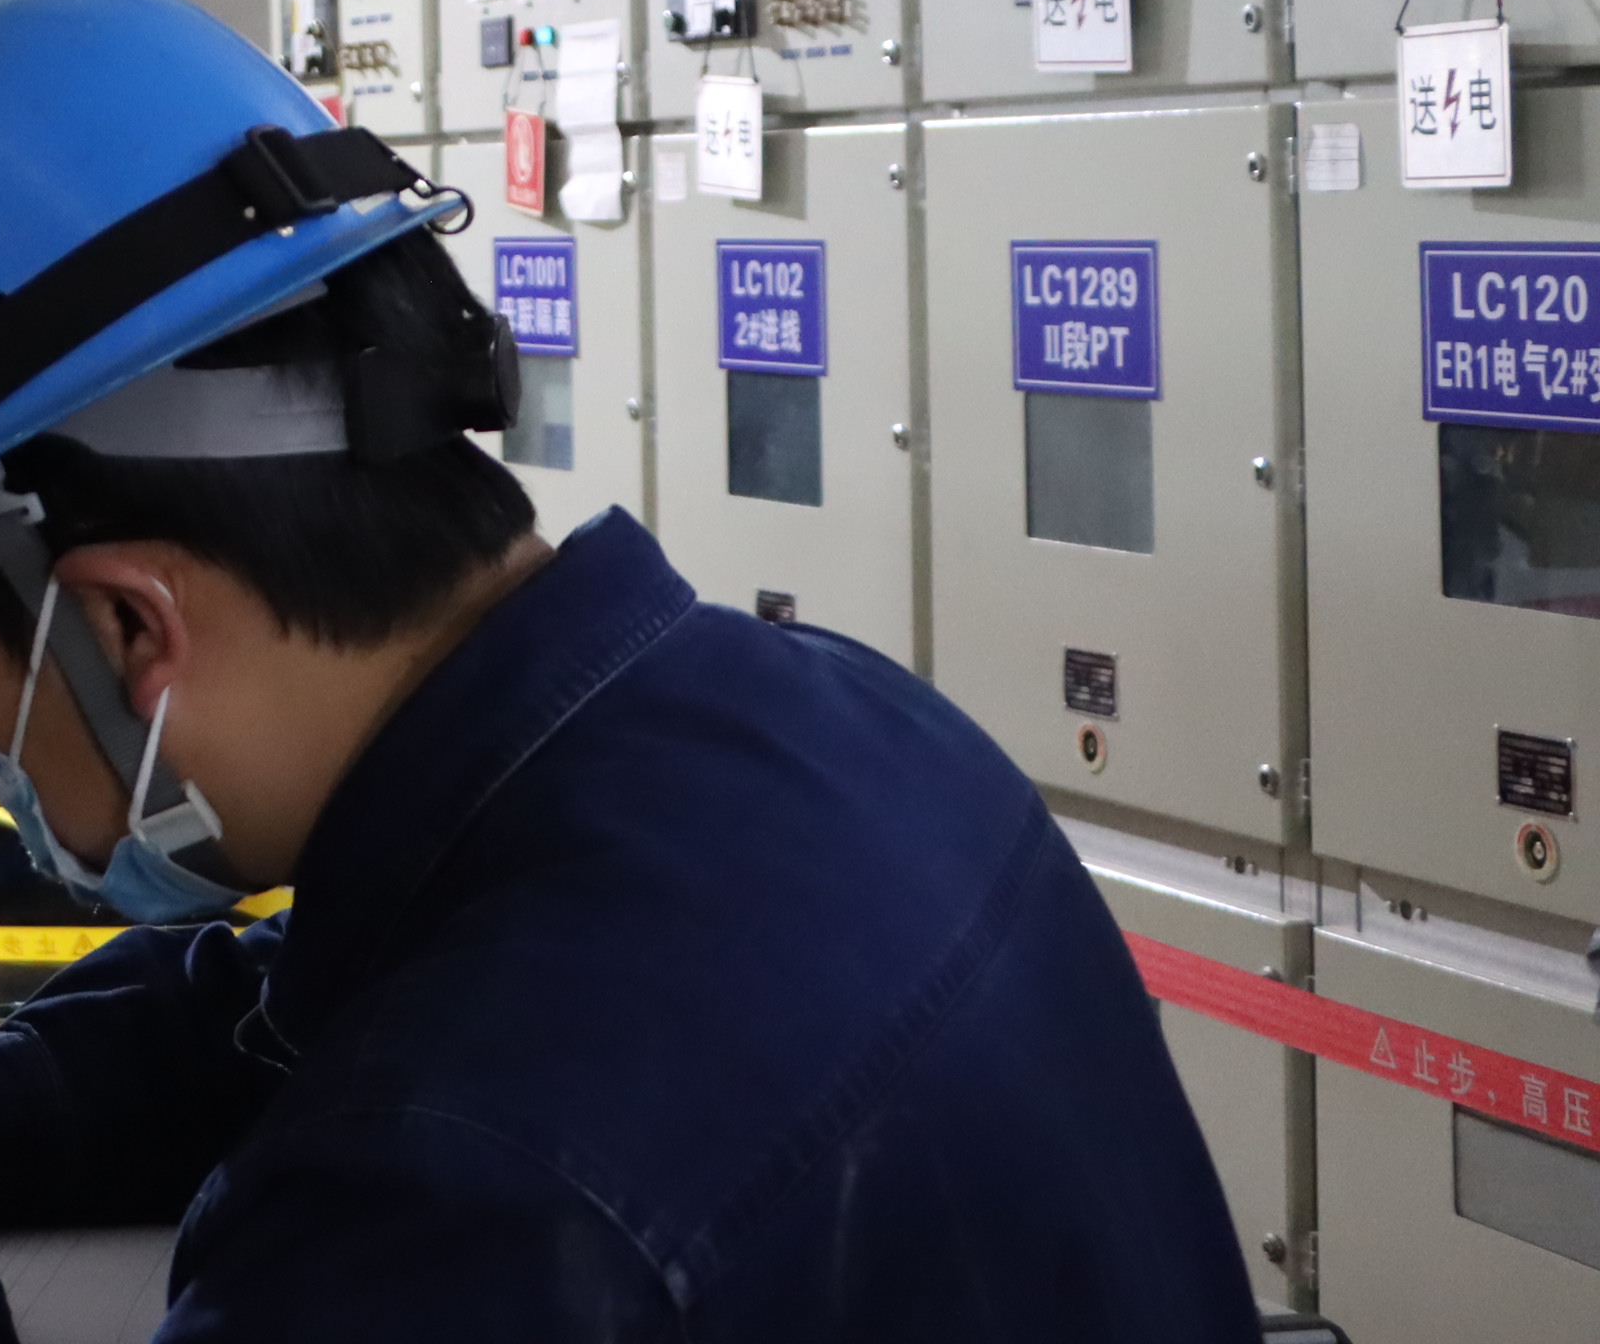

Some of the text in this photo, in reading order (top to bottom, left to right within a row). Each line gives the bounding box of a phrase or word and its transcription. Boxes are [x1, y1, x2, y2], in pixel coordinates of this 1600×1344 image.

[1409, 68, 1497, 135] 送电
[501, 254, 566, 287] LC1001
[731, 260, 804, 297] LC102
[1023, 264, 1139, 307] LC1289
[1452, 271, 1588, 323] LC120
[734, 309, 803, 353] 2#进线
